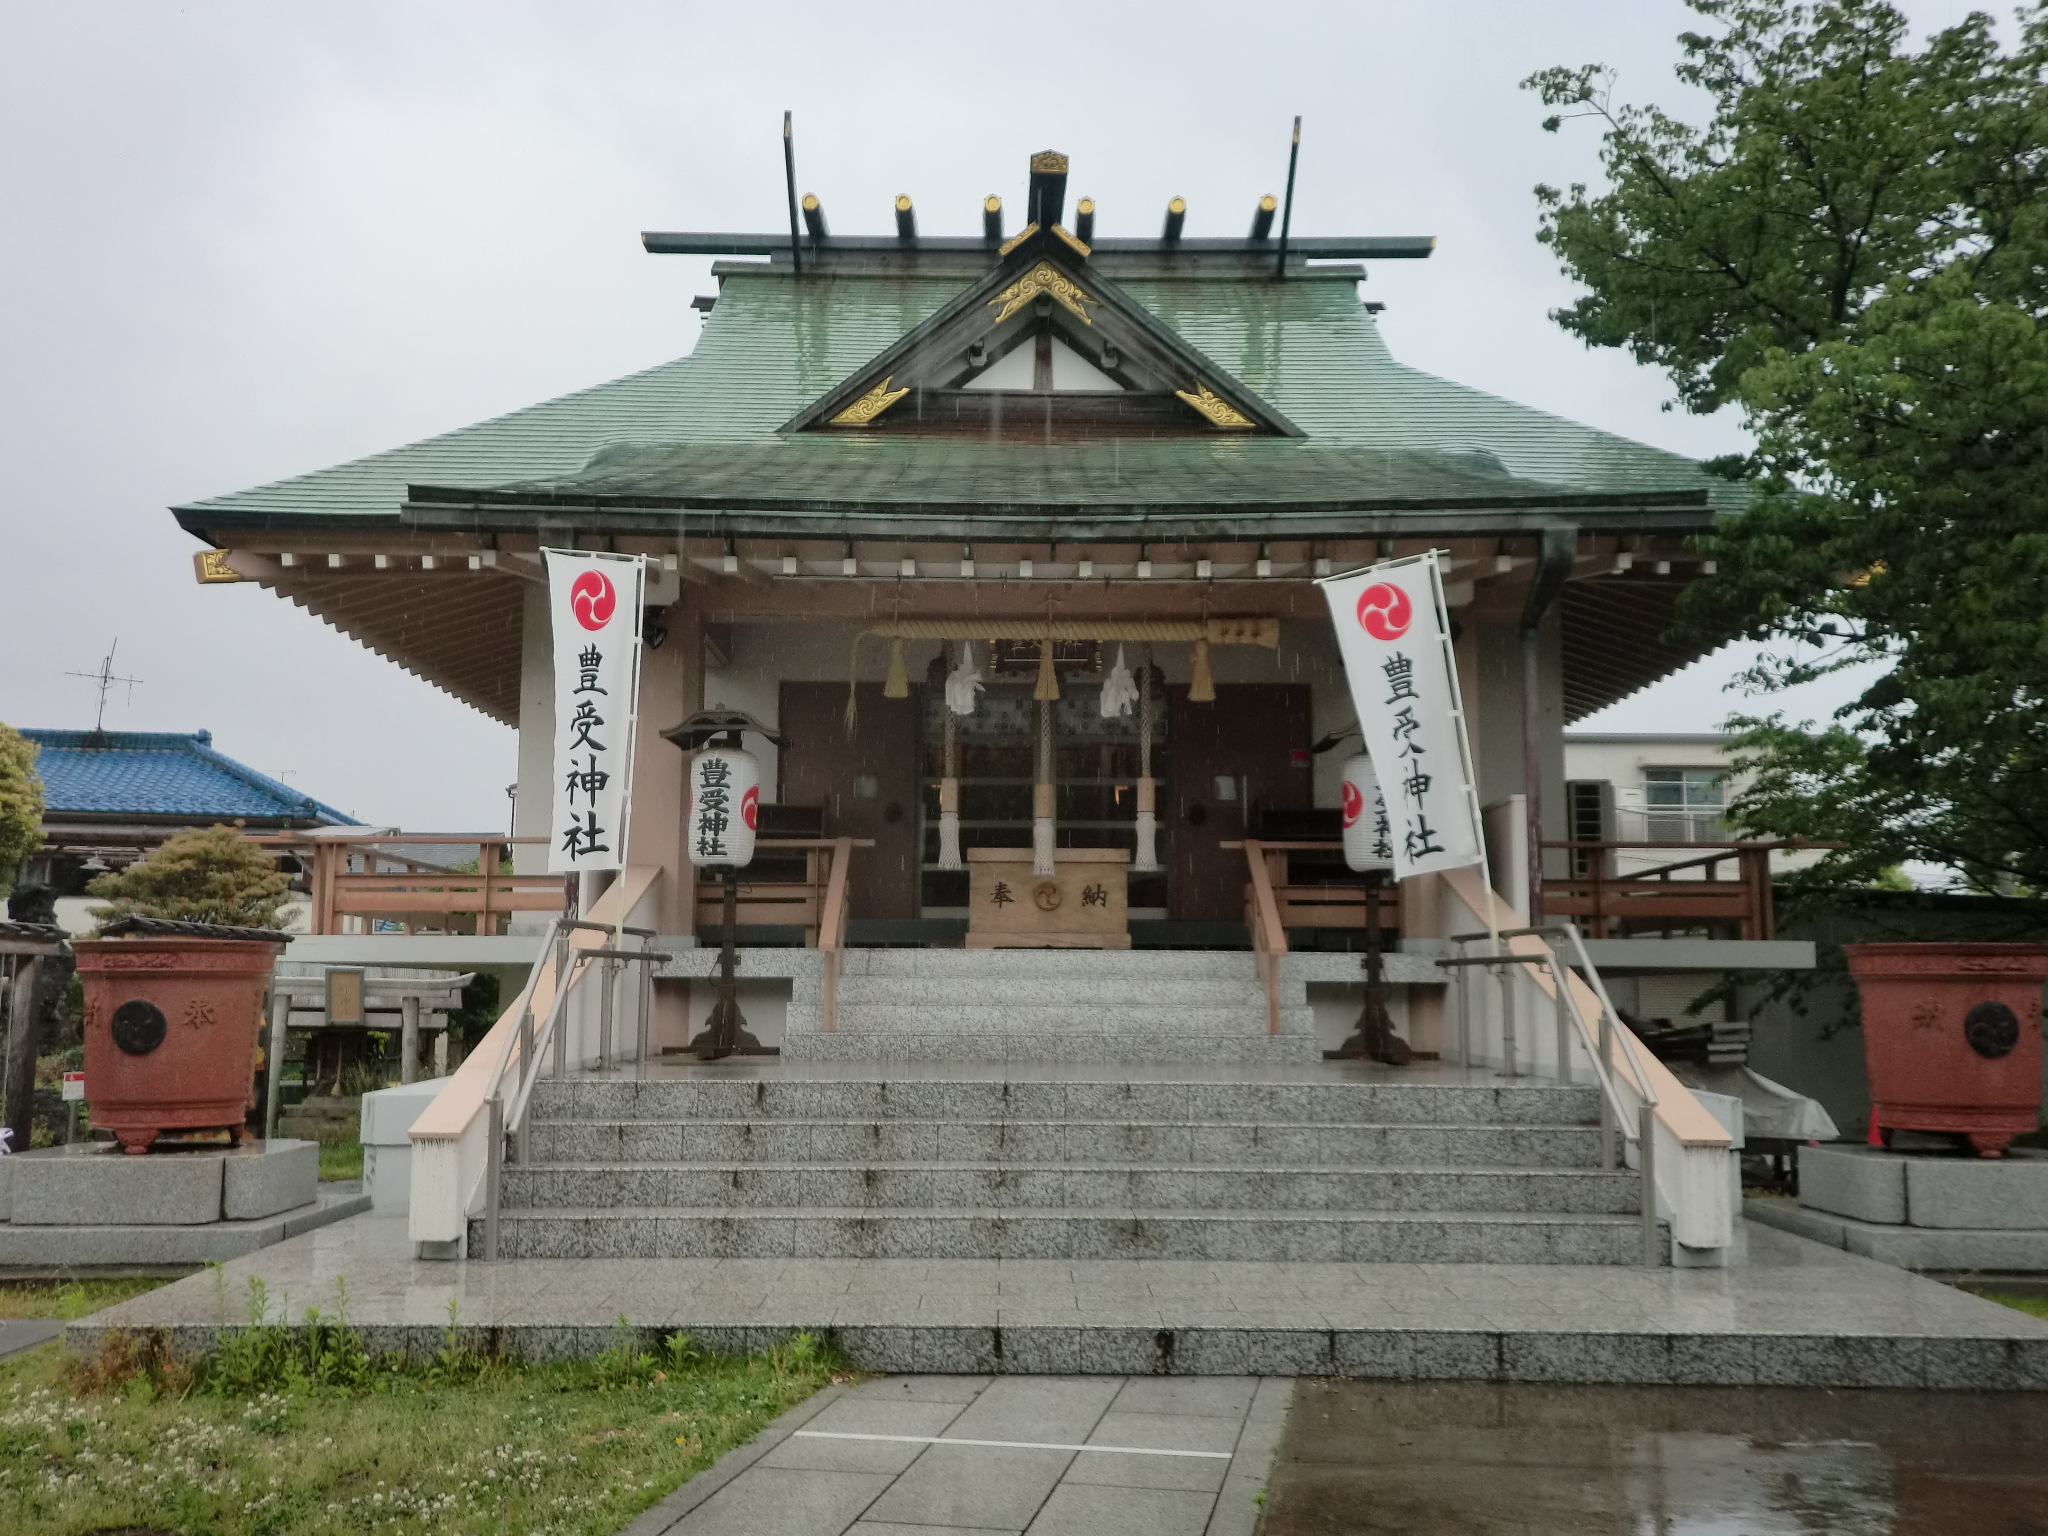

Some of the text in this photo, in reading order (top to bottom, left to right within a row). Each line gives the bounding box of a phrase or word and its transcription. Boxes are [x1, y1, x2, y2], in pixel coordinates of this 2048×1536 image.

[561, 643, 611, 863] 豊受神社
[696, 757, 732, 857] 豊受神社
[1380, 650, 1446, 867] 豊受神社
[990, 881, 1107, 909] 奉 納
